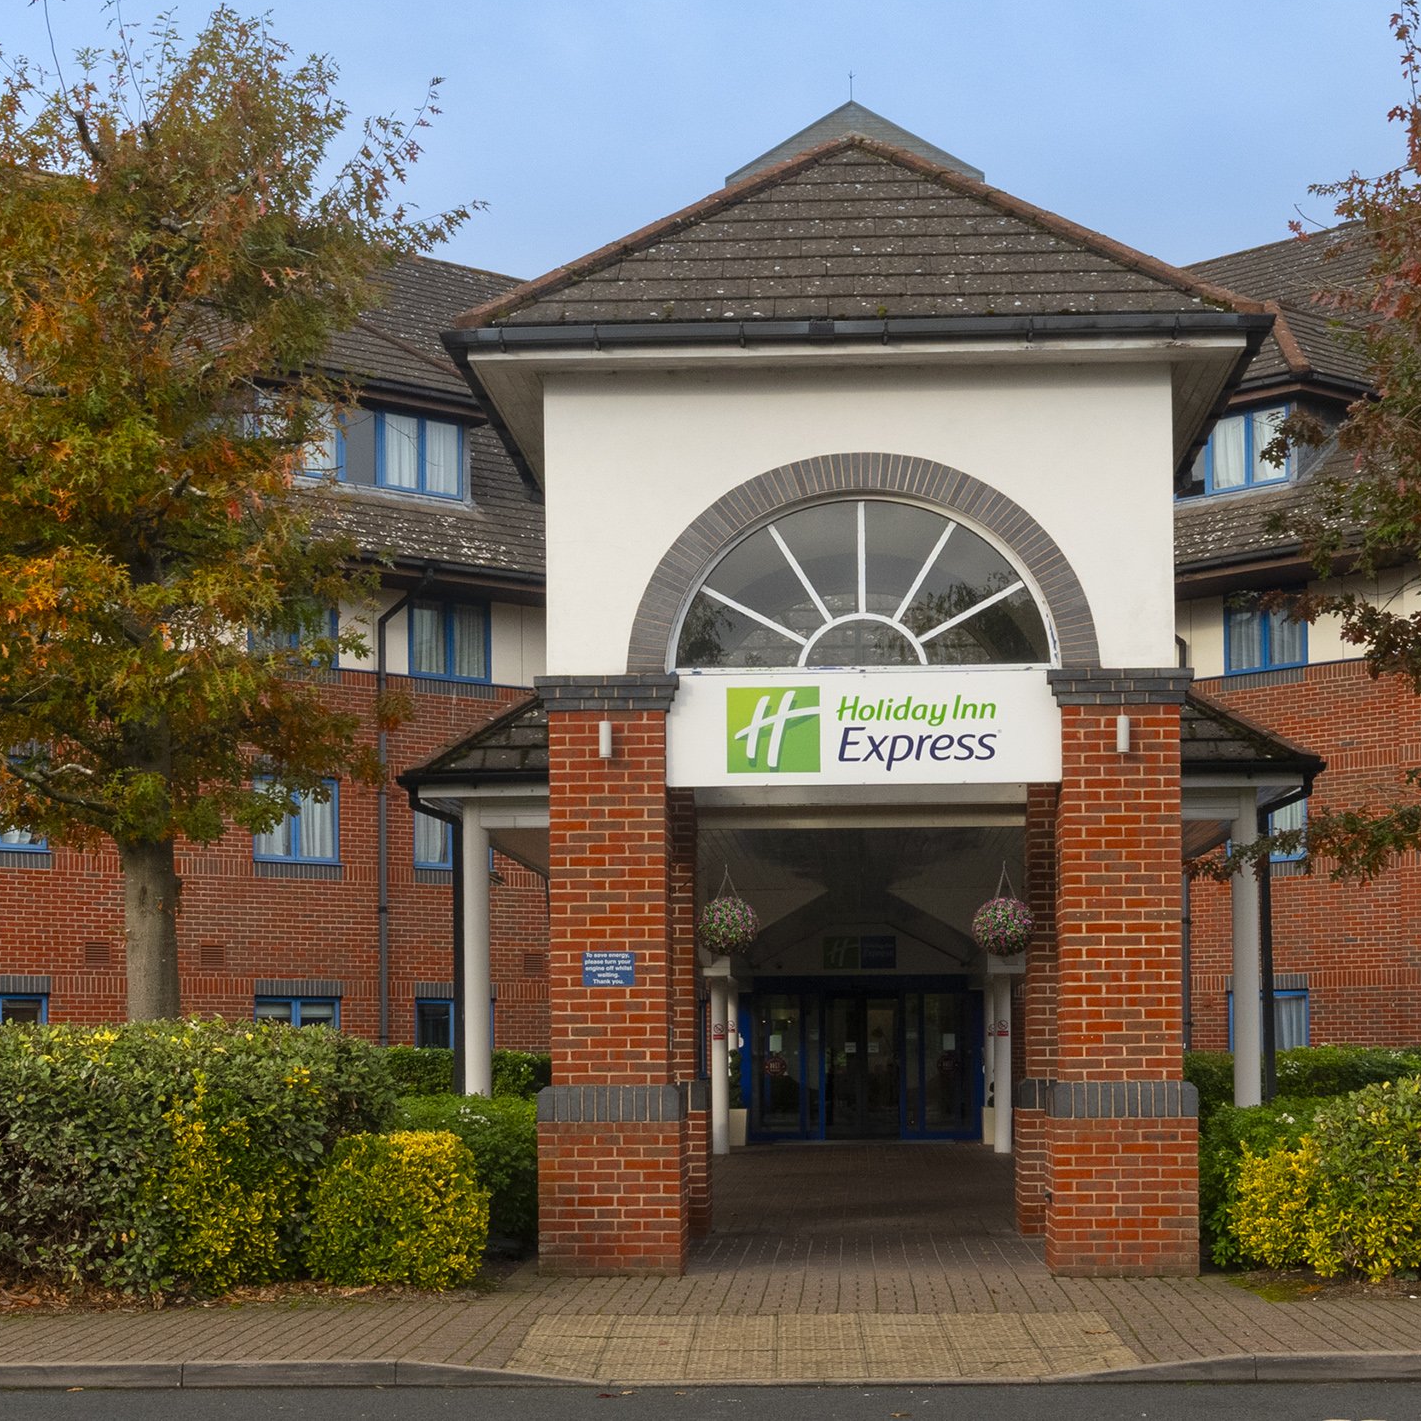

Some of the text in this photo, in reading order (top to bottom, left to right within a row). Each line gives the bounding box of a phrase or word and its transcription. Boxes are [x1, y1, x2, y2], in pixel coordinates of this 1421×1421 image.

[837, 694, 997, 726] Holiday Inn
[838, 727, 997, 771] Express
